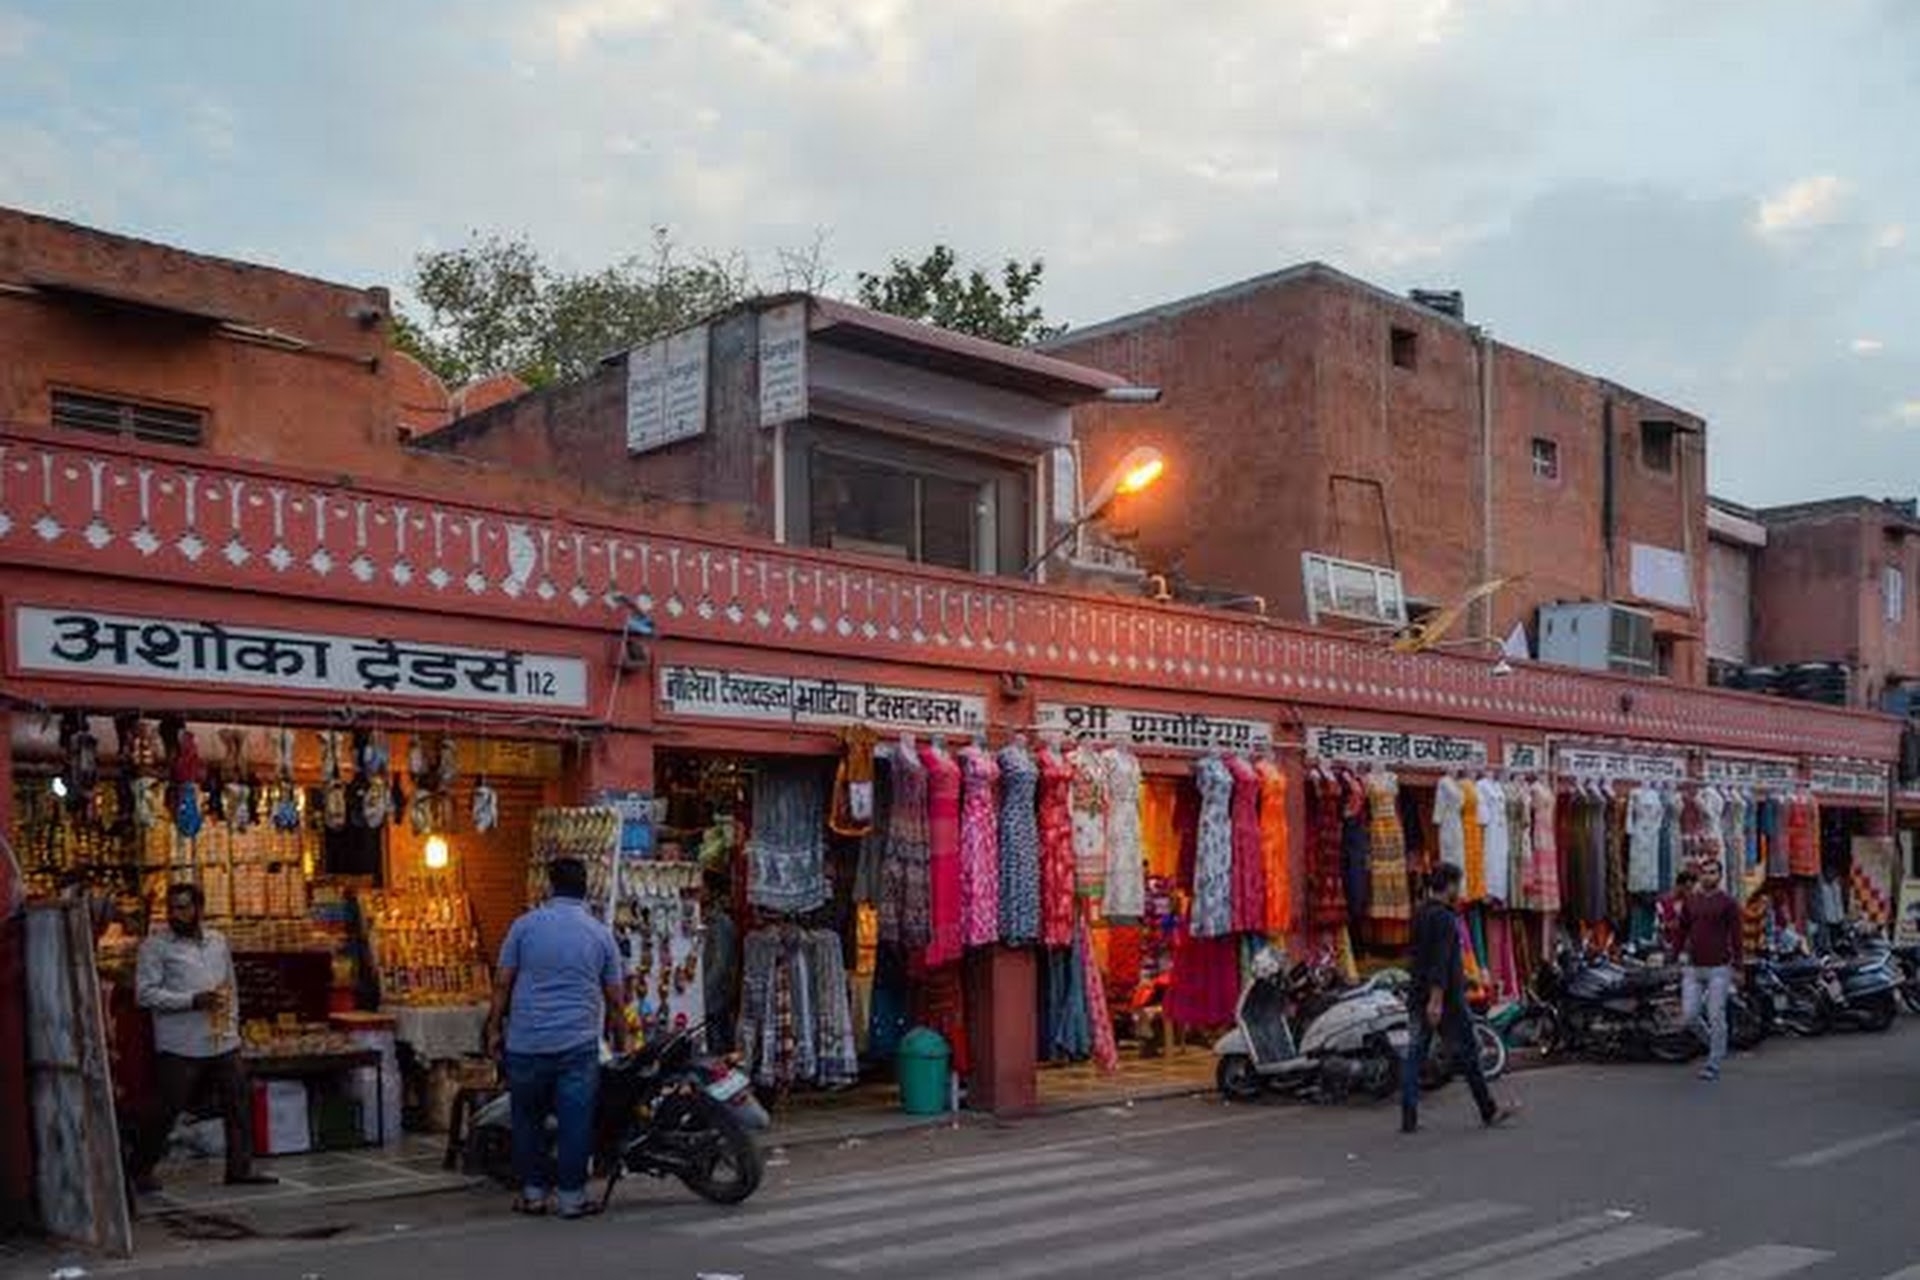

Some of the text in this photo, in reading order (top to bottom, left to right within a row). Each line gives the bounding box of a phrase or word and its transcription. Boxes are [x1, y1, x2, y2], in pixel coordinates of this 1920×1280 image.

[52, 616, 556, 696] अशोका ट्रेडर्स 112
[1064, 705, 1111, 741] श्री
